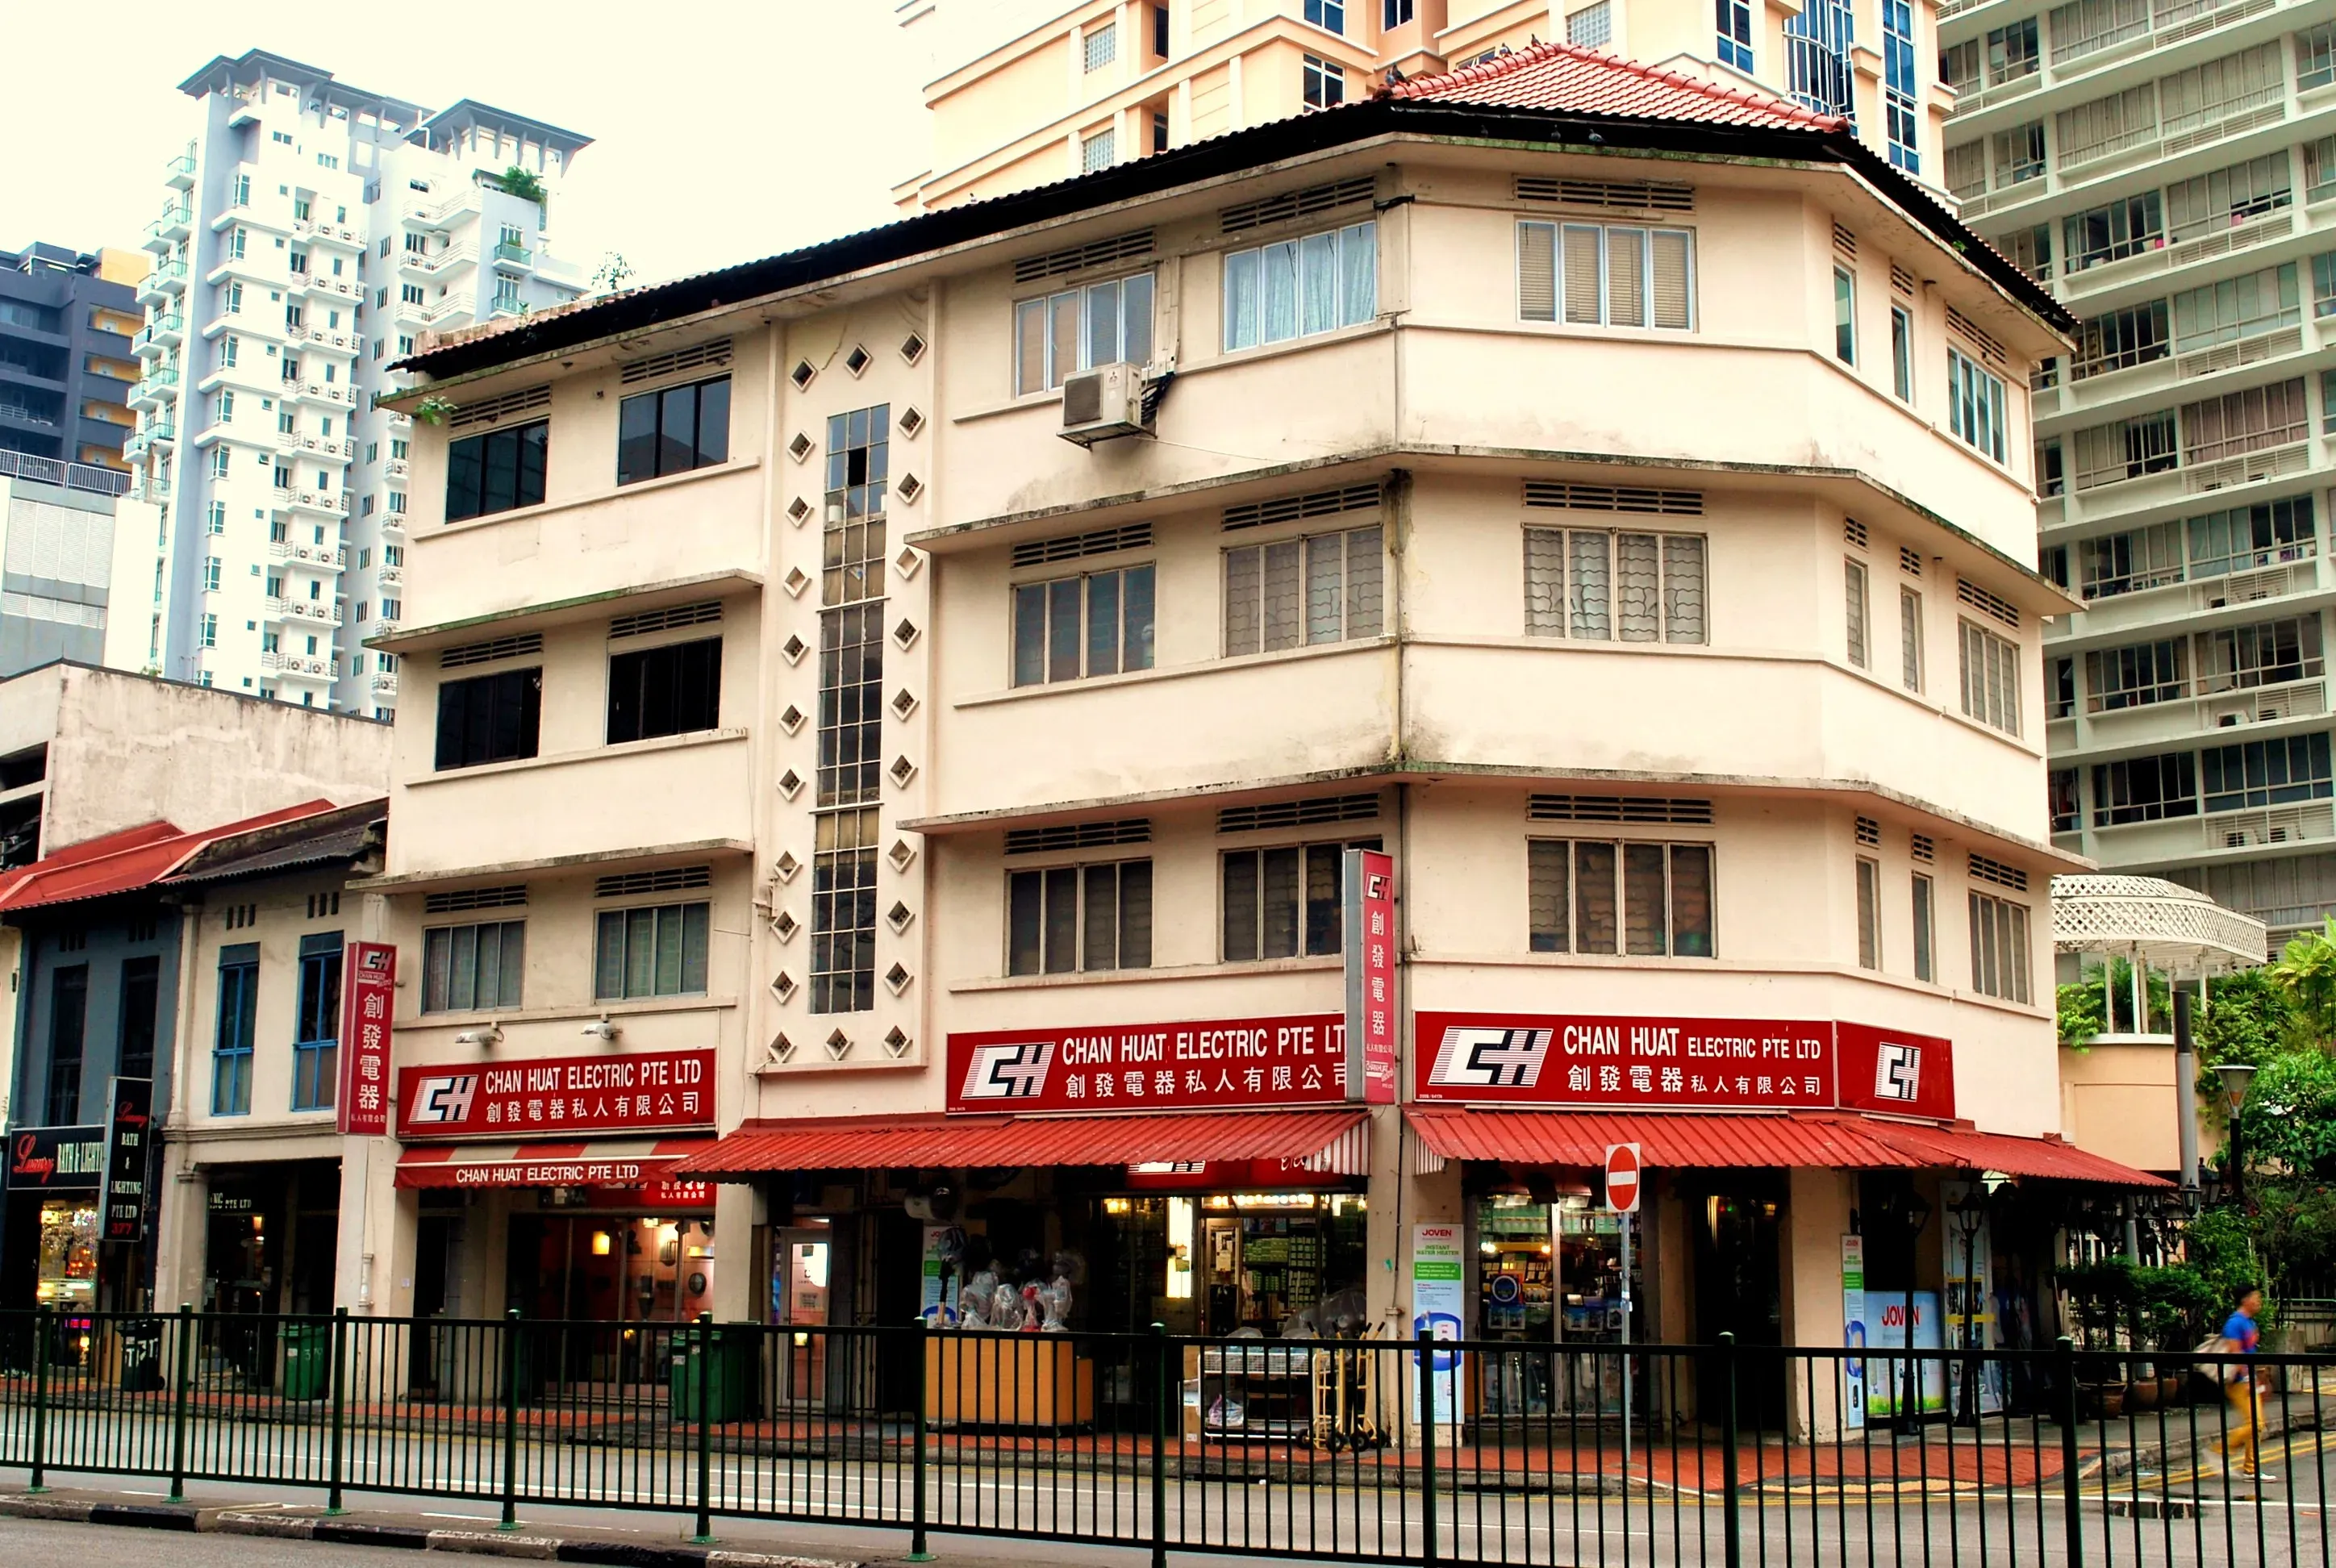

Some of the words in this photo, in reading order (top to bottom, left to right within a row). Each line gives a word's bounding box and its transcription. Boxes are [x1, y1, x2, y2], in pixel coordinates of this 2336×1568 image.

[1371, 910, 1385, 1036] 創發電器
[358, 992, 385, 1111] 創發電器
[1062, 1036, 1112, 1065] CHAN
[1120, 1033, 1167, 1062] HUAT
[1176, 1028, 1268, 1060] ELECTRIC
[1278, 1026, 1314, 1056] PTE
[1324, 1024, 1345, 1053] LT
[1563, 1025, 1620, 1055] CHAN
[1631, 1027, 1680, 1056] HUAT
[1687, 1037, 1756, 1058] ELECTRIC
[1762, 1039, 1790, 1058] PTE
[1796, 1040, 1821, 1059] LTD
[486, 1069, 521, 1094] CHAN
[528, 1066, 561, 1091] HUAT
[567, 1062, 634, 1090] ELECTRIC
[640, 1061, 668, 1086] PTE
[674, 1059, 701, 1084] LTD
[486, 1091, 699, 1124] 創發電器私人有限公司
[121, 1132, 139, 1146] BATH
[56, 1142, 73, 1174] BATH
[124, 1157, 131, 1170] &
[456, 1168, 489, 1183] CHAN
[493, 1166, 523, 1182] HUAT
[527, 1166, 584, 1180] ELECTRIC
[588, 1166, 611, 1179] PTE
[615, 1164, 639, 1178] LTD
[110, 1181, 142, 1195] LIGHTING
[111, 1204, 123, 1217] PTE
[125, 1205, 138, 1218] LTD
[240, 1199, 252, 1208] LTD
[111, 1223, 133, 1235] 377
[1422, 1228, 1452, 1236] JOVEN
[1881, 1305, 1919, 1327] JOVN
